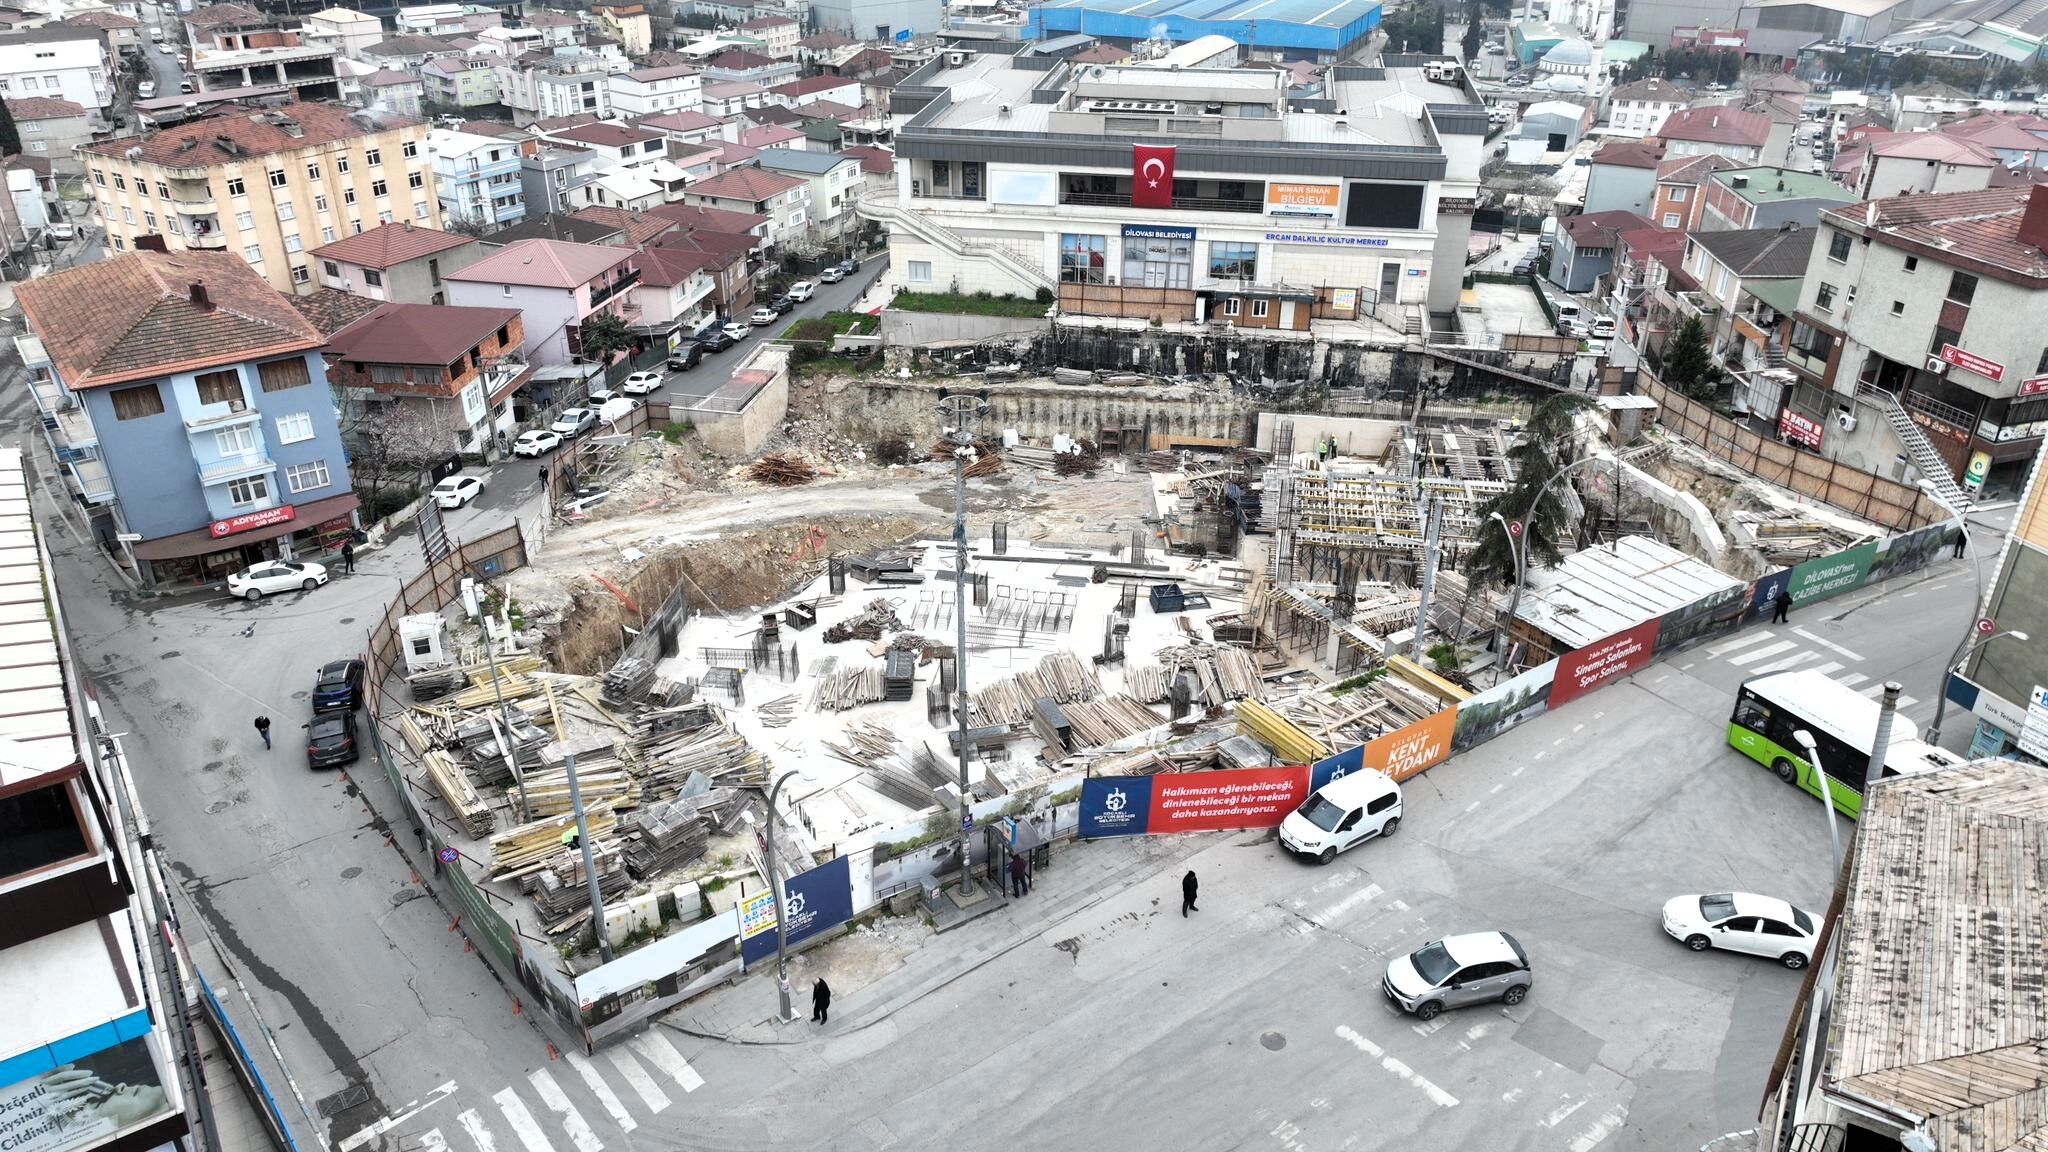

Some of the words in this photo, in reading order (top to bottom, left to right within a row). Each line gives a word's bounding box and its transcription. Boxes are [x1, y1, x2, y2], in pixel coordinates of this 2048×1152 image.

[1280, 194, 1326, 206] BİLGİEVİ
[1125, 228, 1155, 238] DİLOVASI
[1265, 233, 1292, 241] ERCAN
[232, 509, 281, 526] ADIYAMAN
[1574, 658, 1606, 677] Sinema
[1579, 672, 1600, 688] Spor
[1984, 703, 1998, 715] Türk
[1387, 735, 1430, 764] KENT
[1161, 788, 1217, 797] Halkımızın
[1162, 797, 1240, 809] dinlenebileceği
[1241, 795, 1255, 803] bir
[1257, 793, 1290, 801] mekan
[1171, 810, 1198, 818] daha
